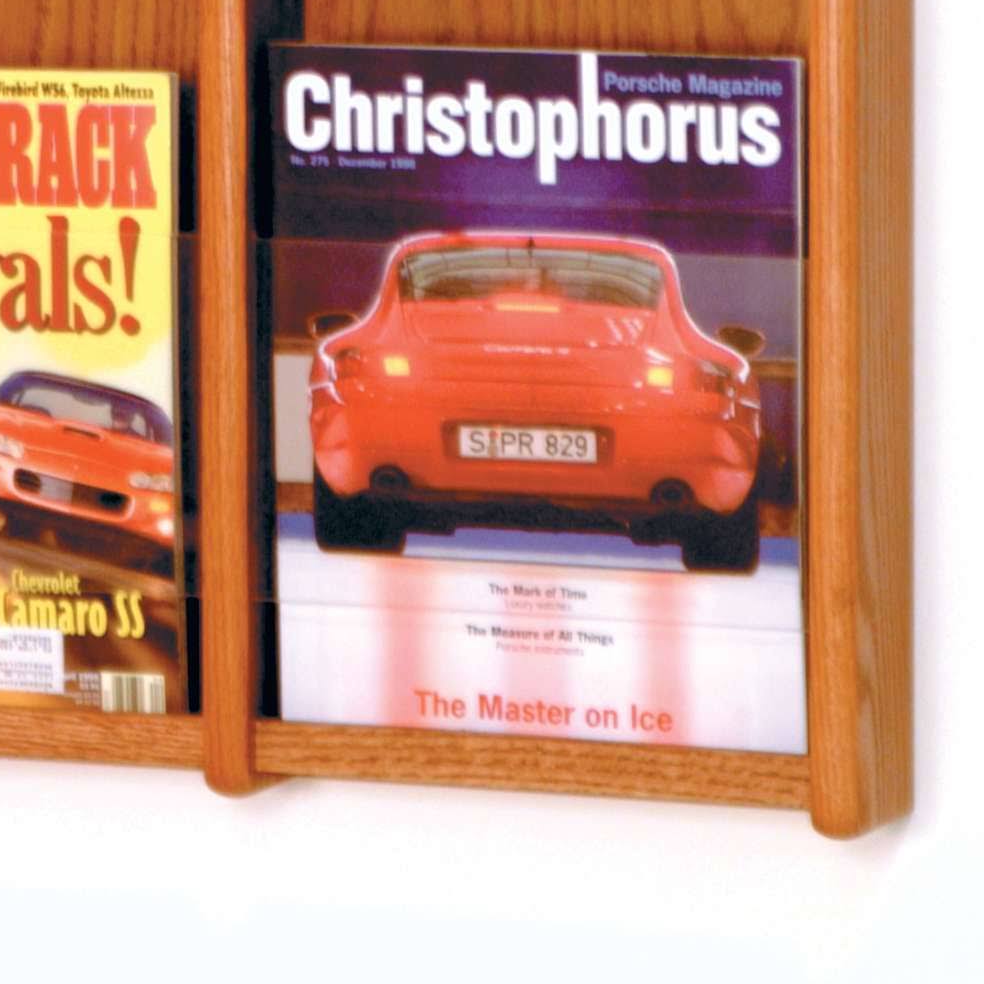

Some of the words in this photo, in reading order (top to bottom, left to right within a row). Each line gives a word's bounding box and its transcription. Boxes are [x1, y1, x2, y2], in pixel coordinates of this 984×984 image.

[73, 83, 109, 105] Toyota
[604, 71, 682, 93] Porsche
[689, 74, 782, 98] Magazine
[286, 51, 782, 184] Christophorus
[545, 434, 588, 458] 829
[11, 569, 81, 595] Chevrolet
[489, 583, 509, 596] The
[514, 584, 541, 597] Mark
[545, 587, 556, 599] of
[561, 587, 587, 600] Time
[115, 590, 145, 639] SS
[466, 624, 486, 636] The
[491, 626, 539, 639] Measure
[544, 629, 554, 640] of
[559, 630, 572, 642] All
[577, 631, 614, 646] Things
[415, 689, 466, 718] The
[478, 694, 575, 725] Master
[584, 707, 618, 729] on
[631, 704, 673, 732] Ice
